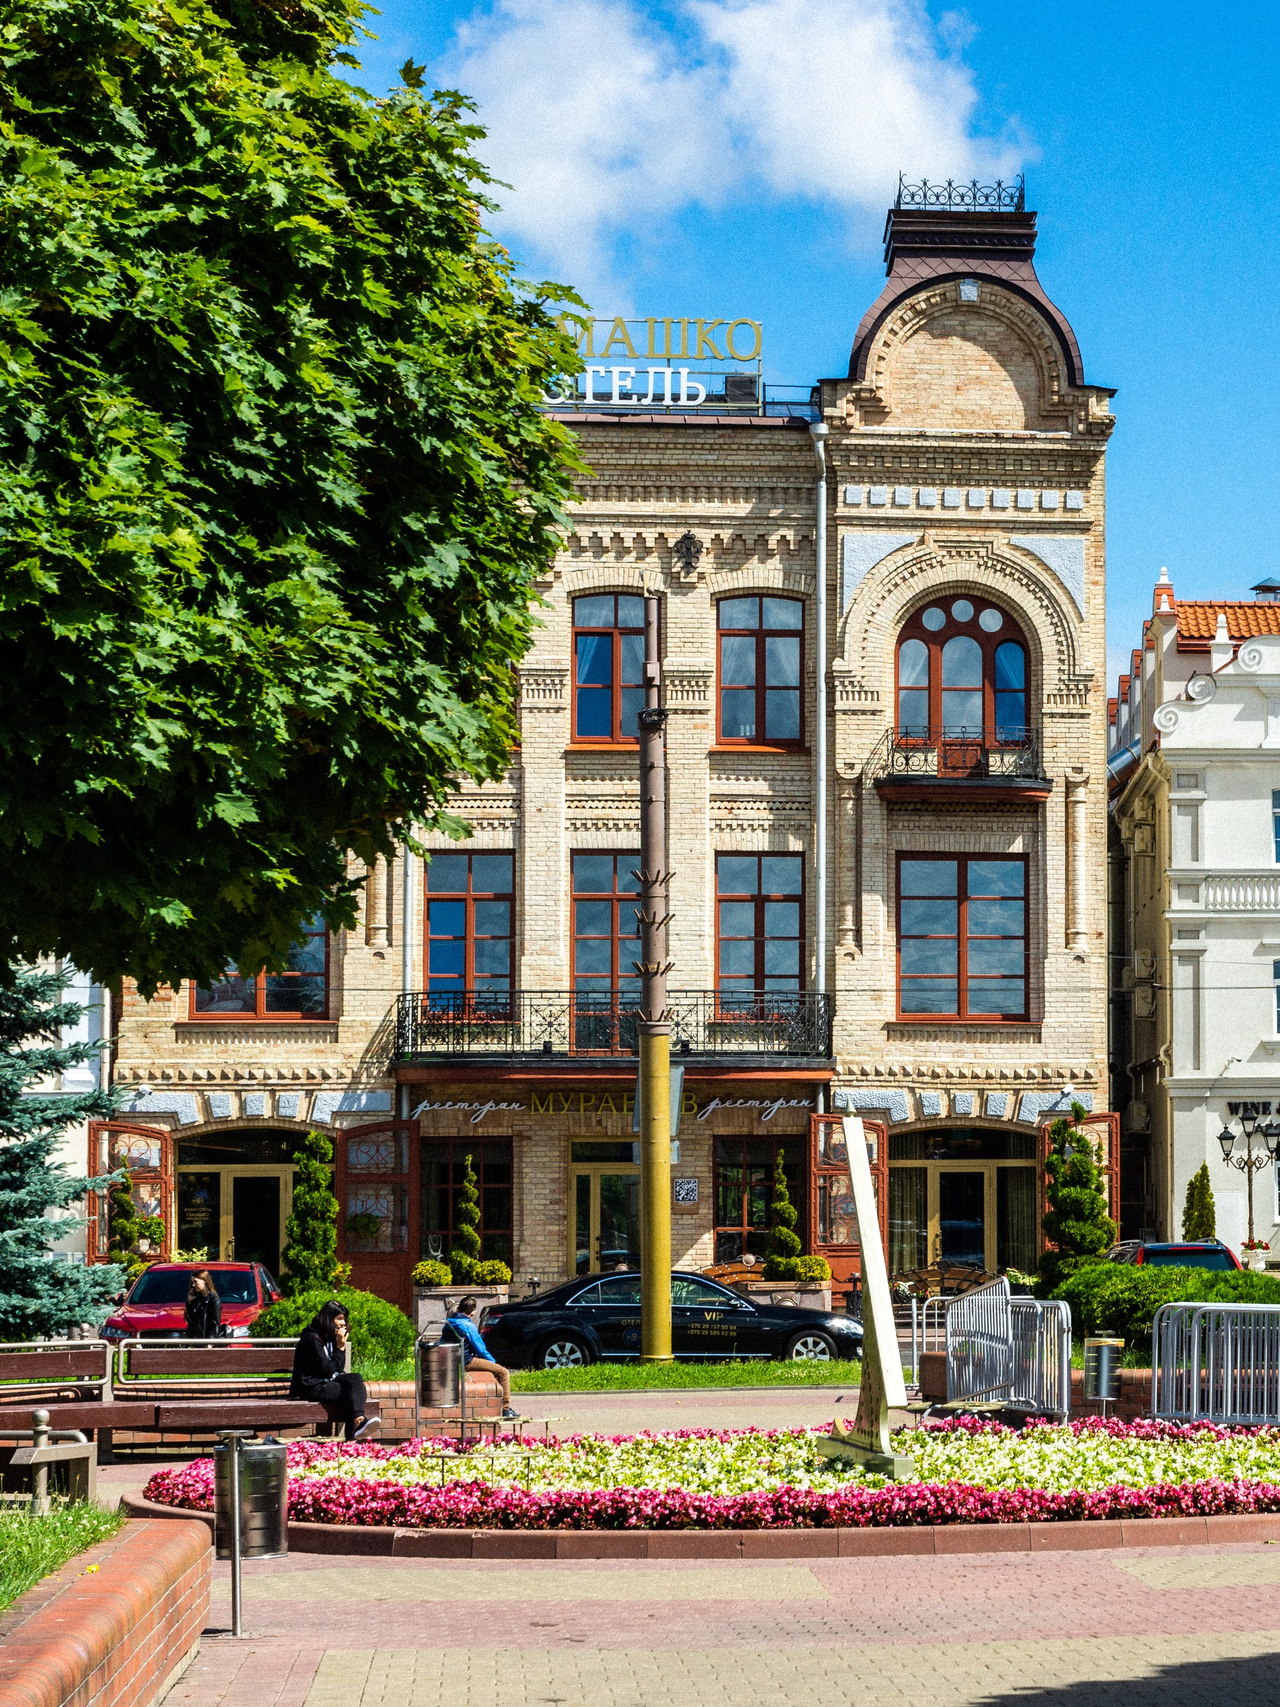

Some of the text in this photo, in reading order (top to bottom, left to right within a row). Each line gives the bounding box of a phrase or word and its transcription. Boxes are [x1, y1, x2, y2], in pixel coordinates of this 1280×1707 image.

[553, 316, 762, 361] МАШКО
[410, 1091, 815, 1123] ресторан МУРАВВ ресторан
[1227, 1101, 1272, 1115] WINE
[704, 1311, 724, 1321] VIP
